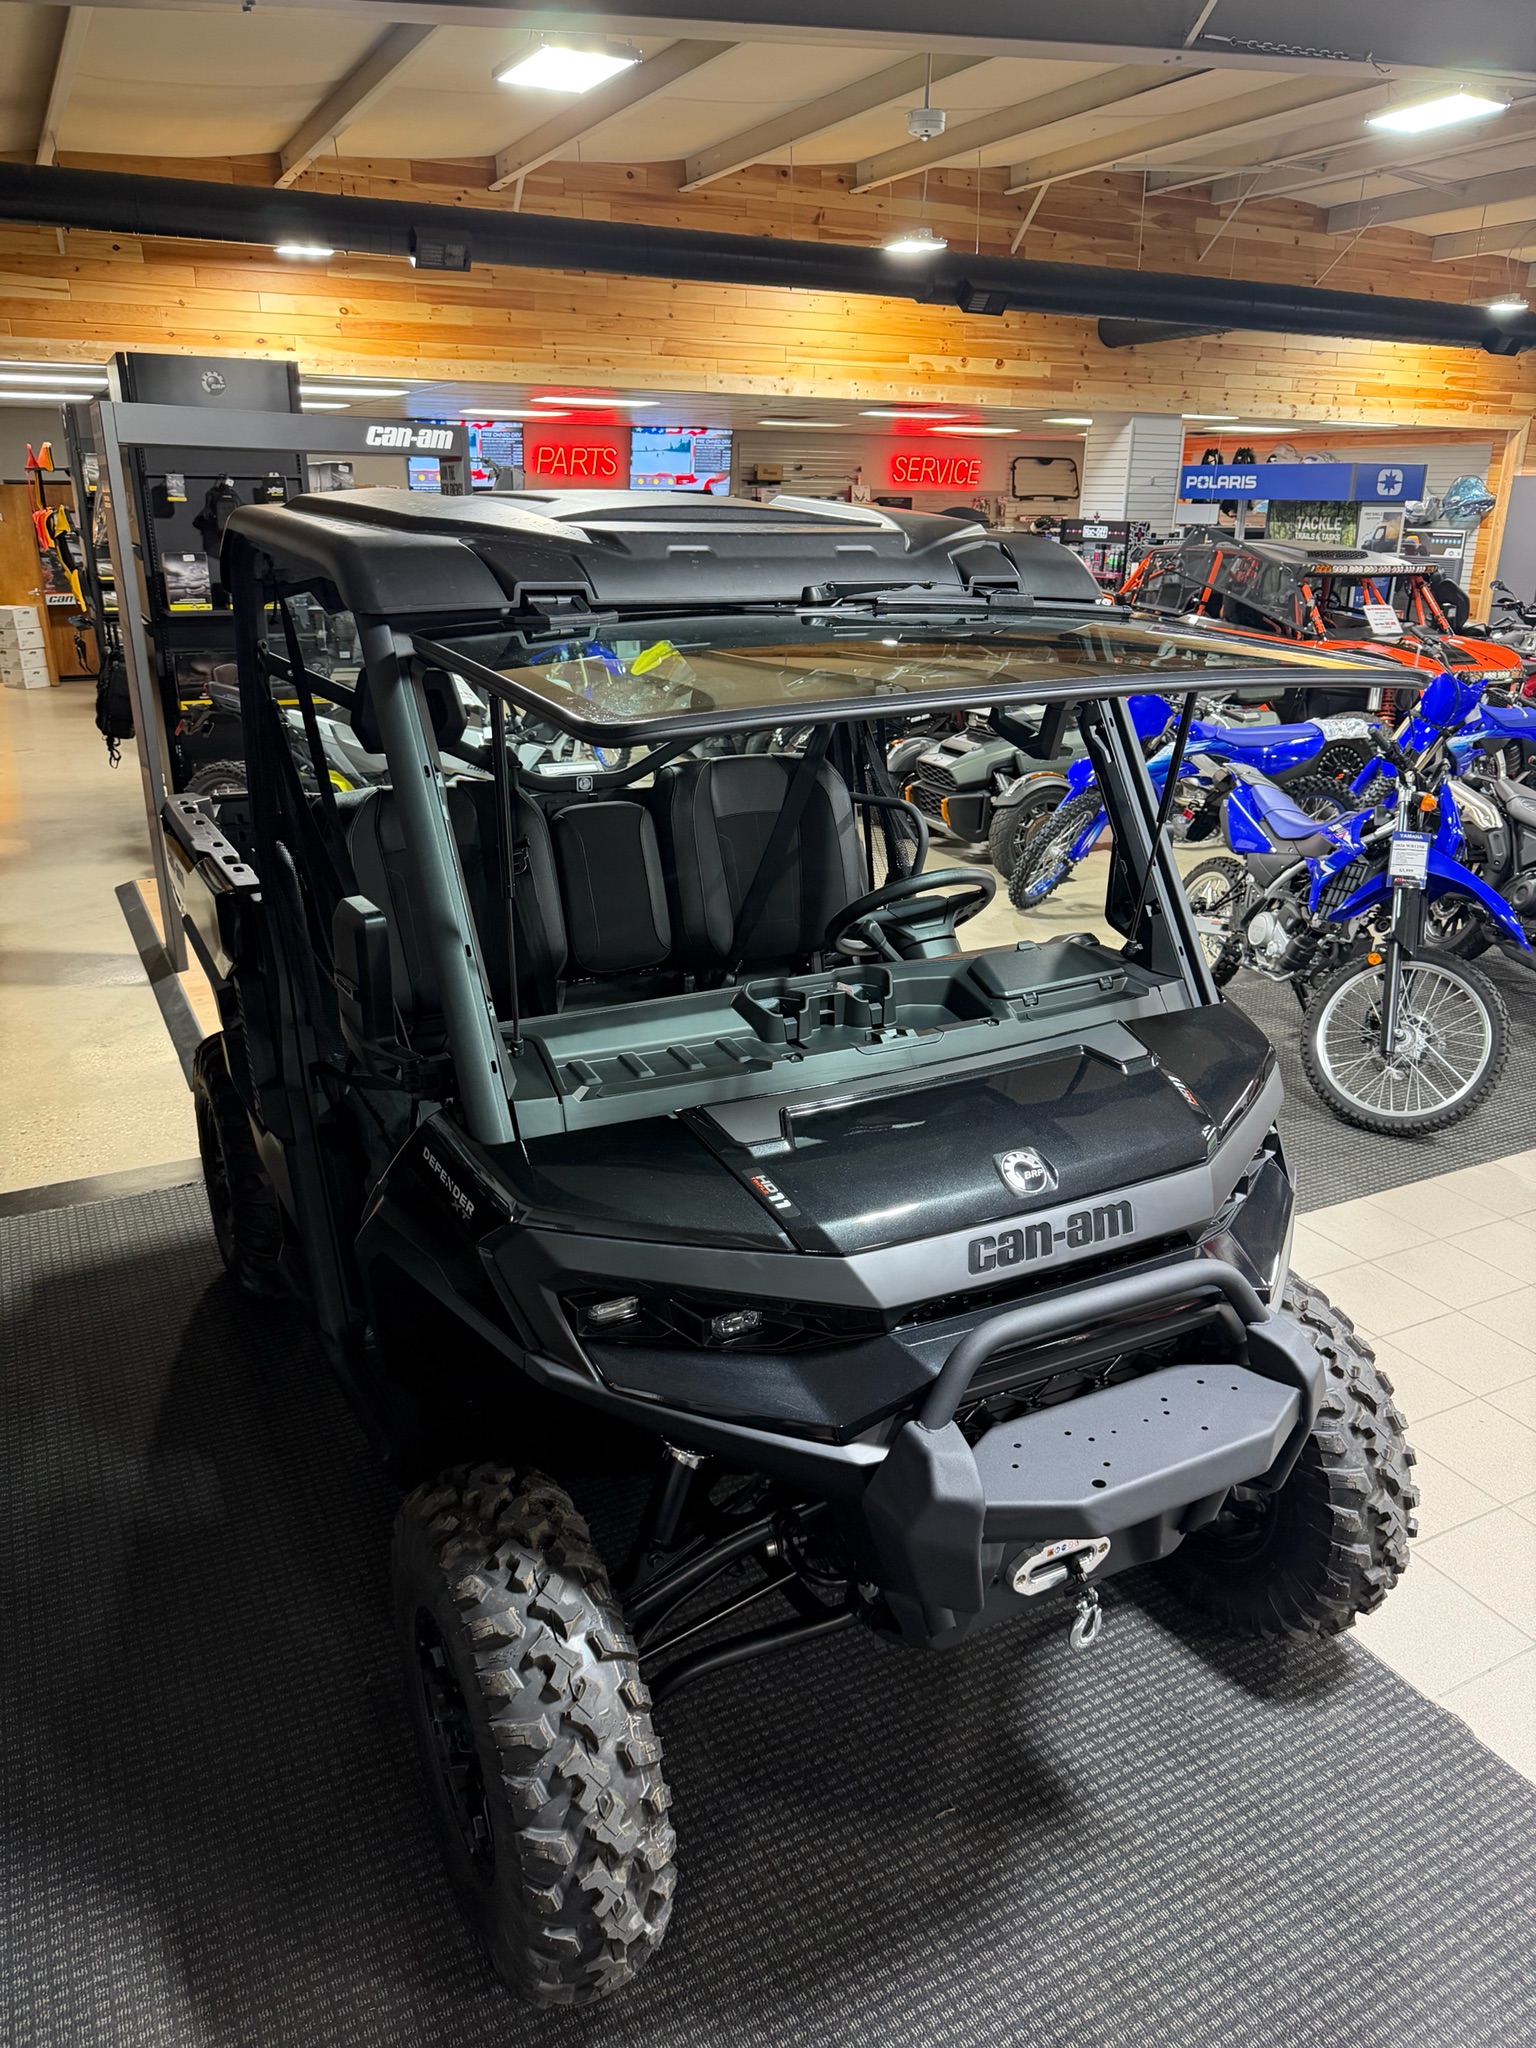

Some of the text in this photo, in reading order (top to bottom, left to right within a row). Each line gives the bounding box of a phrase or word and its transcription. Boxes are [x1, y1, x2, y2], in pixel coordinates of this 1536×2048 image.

[365, 425, 454, 450] can-am
[536, 446, 617, 476] PARTS
[893, 456, 982, 484] SERVICE
[1185, 475, 1257, 489] POLARIS
[1296, 516, 1342, 530] TACKLE
[1295, 532, 1315, 540] TRAILS
[1321, 533, 1341, 541] TASKS
[422, 1146, 475, 1217] DEFENDER
[1023, 1168, 1044, 1180] BRP
[967, 1199, 1134, 1276] can-am
